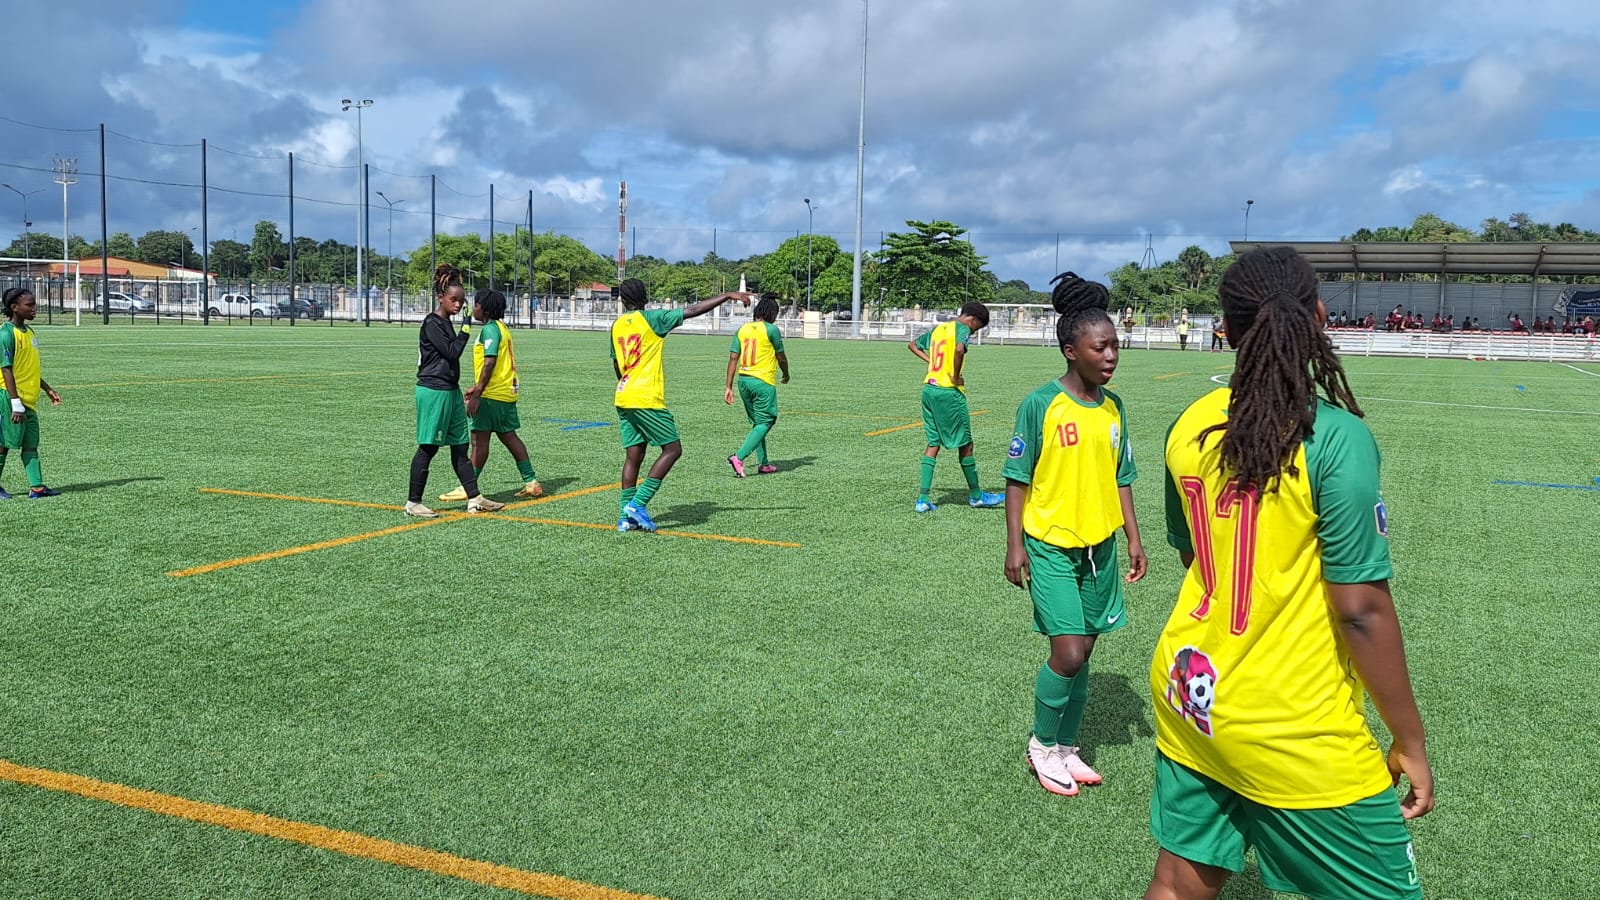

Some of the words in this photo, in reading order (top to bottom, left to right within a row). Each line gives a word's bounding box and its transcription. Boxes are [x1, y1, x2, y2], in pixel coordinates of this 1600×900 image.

[617, 333, 641, 371] 13
[742, 337, 757, 367] 11
[932, 339, 946, 372] 16
[1057, 422, 1079, 448] 18
[1179, 476, 1259, 636] 17
